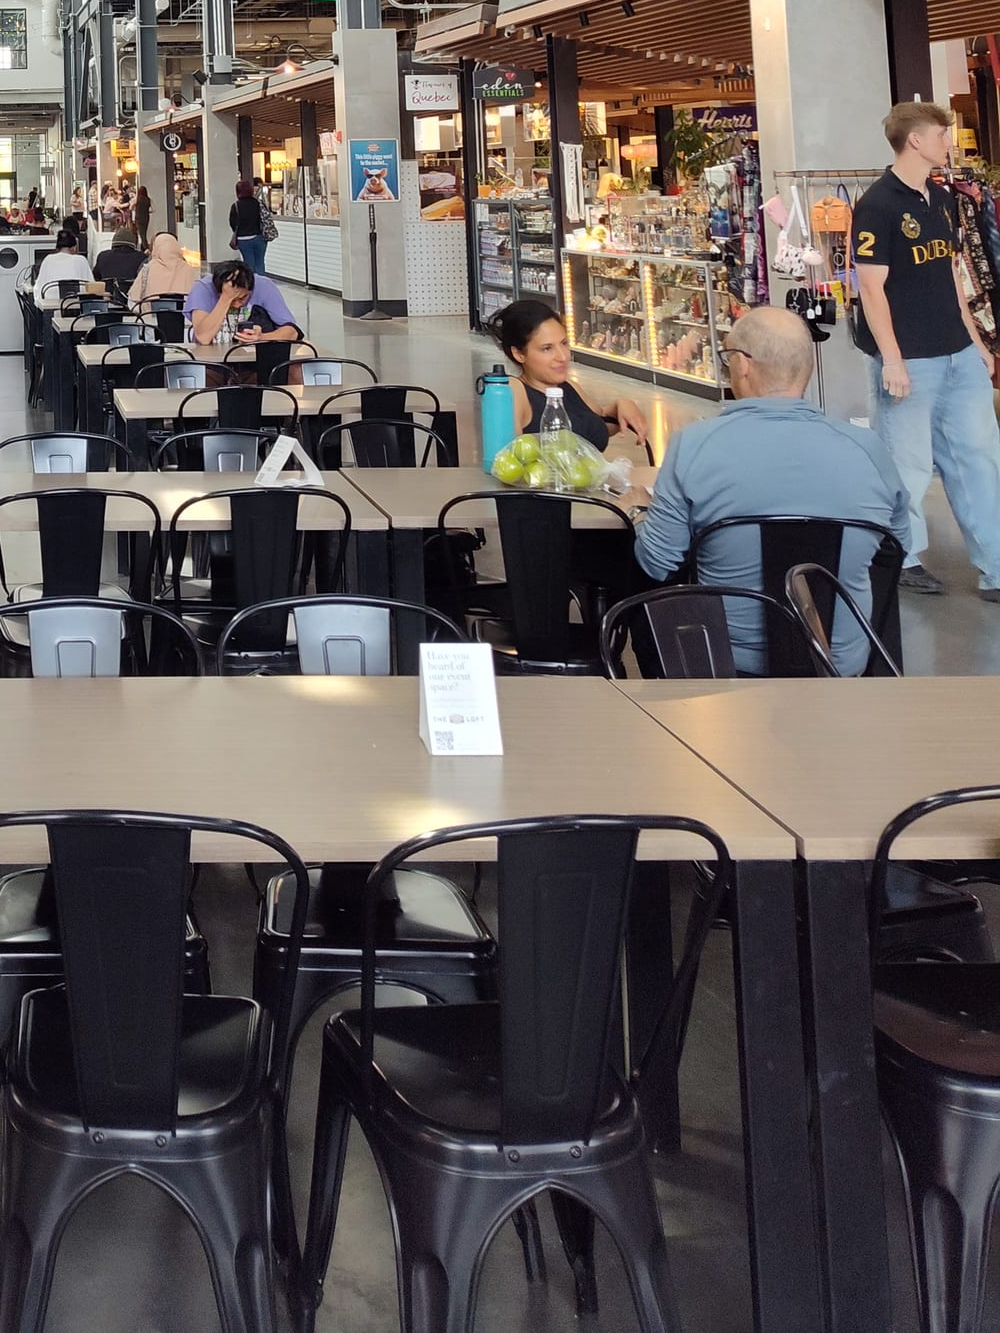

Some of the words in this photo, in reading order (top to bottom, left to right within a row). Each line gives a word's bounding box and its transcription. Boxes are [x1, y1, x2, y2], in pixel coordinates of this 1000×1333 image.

[480, 76, 523, 90] eden
[482, 88, 525, 97] ESSENTIALS
[698, 109, 753, 129] Hearts
[857, 231, 876, 257] 2
